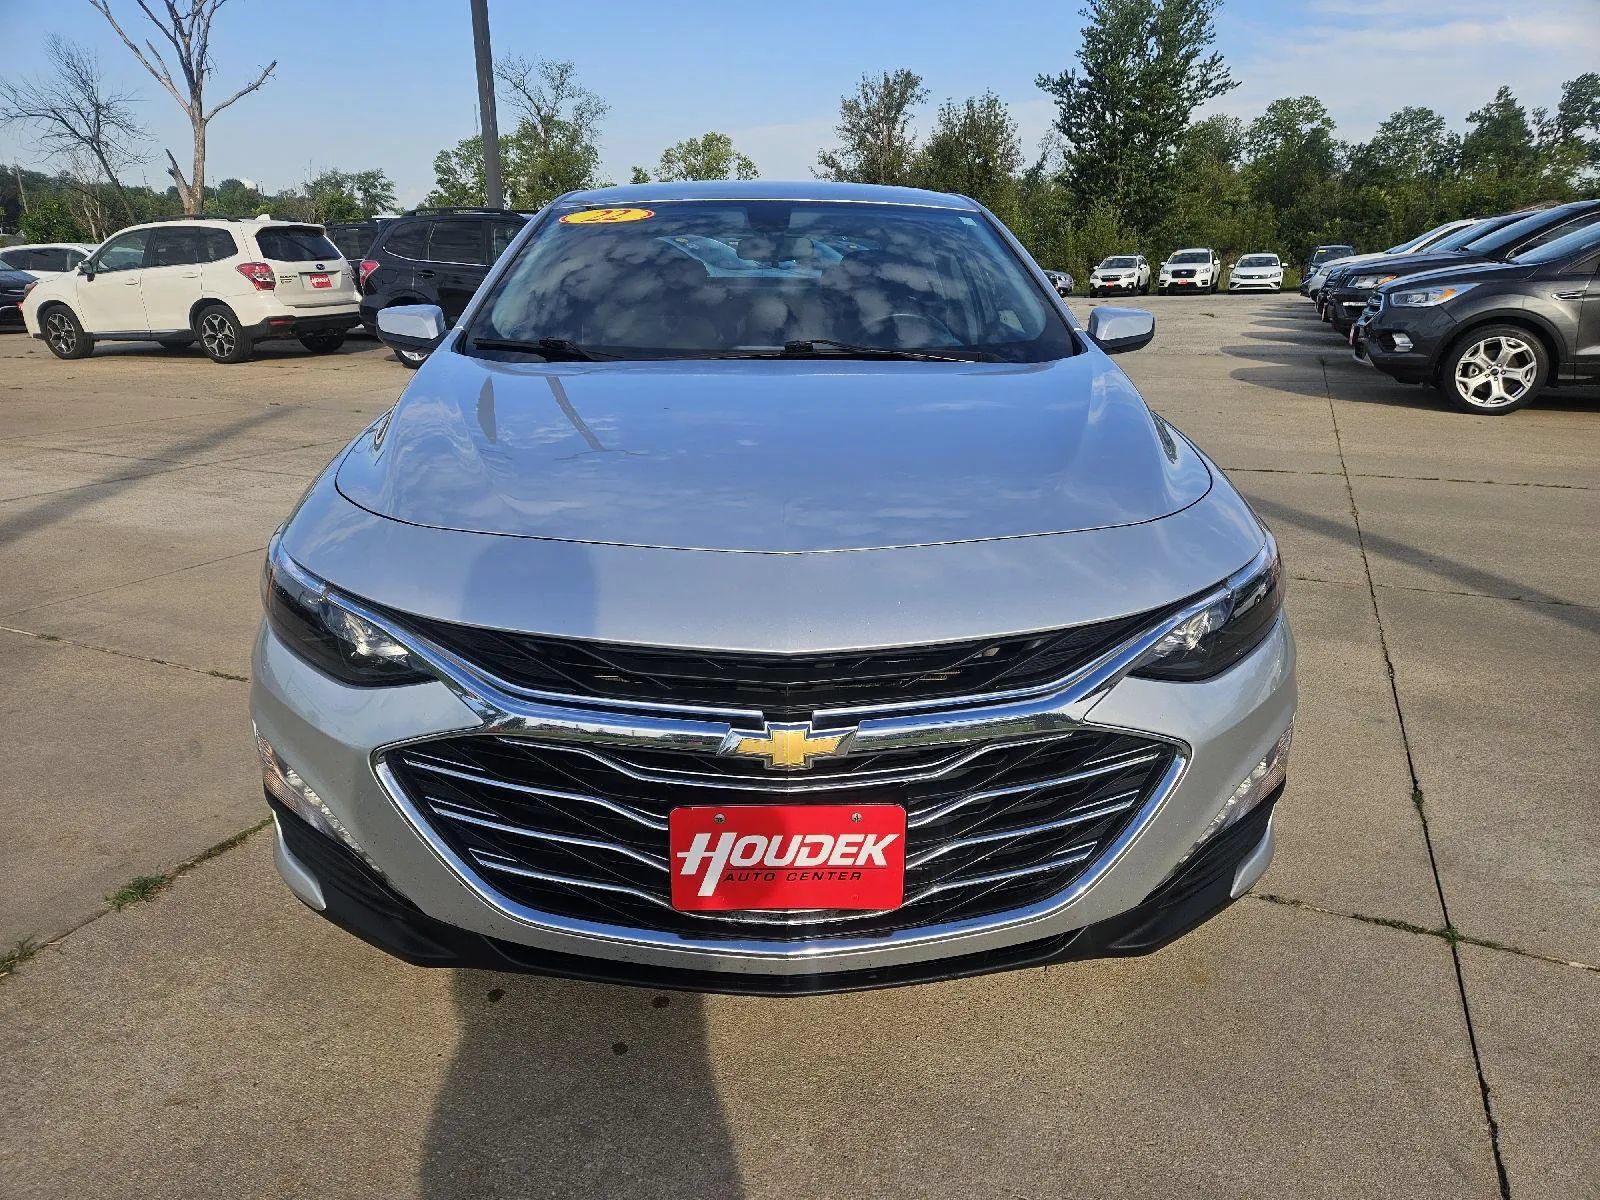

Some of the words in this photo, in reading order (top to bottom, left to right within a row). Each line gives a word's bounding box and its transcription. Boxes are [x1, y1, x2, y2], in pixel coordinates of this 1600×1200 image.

[677, 832, 899, 896] HOUDEK
[725, 872, 775, 882] AUTO
[787, 872, 862, 881] CENTER
